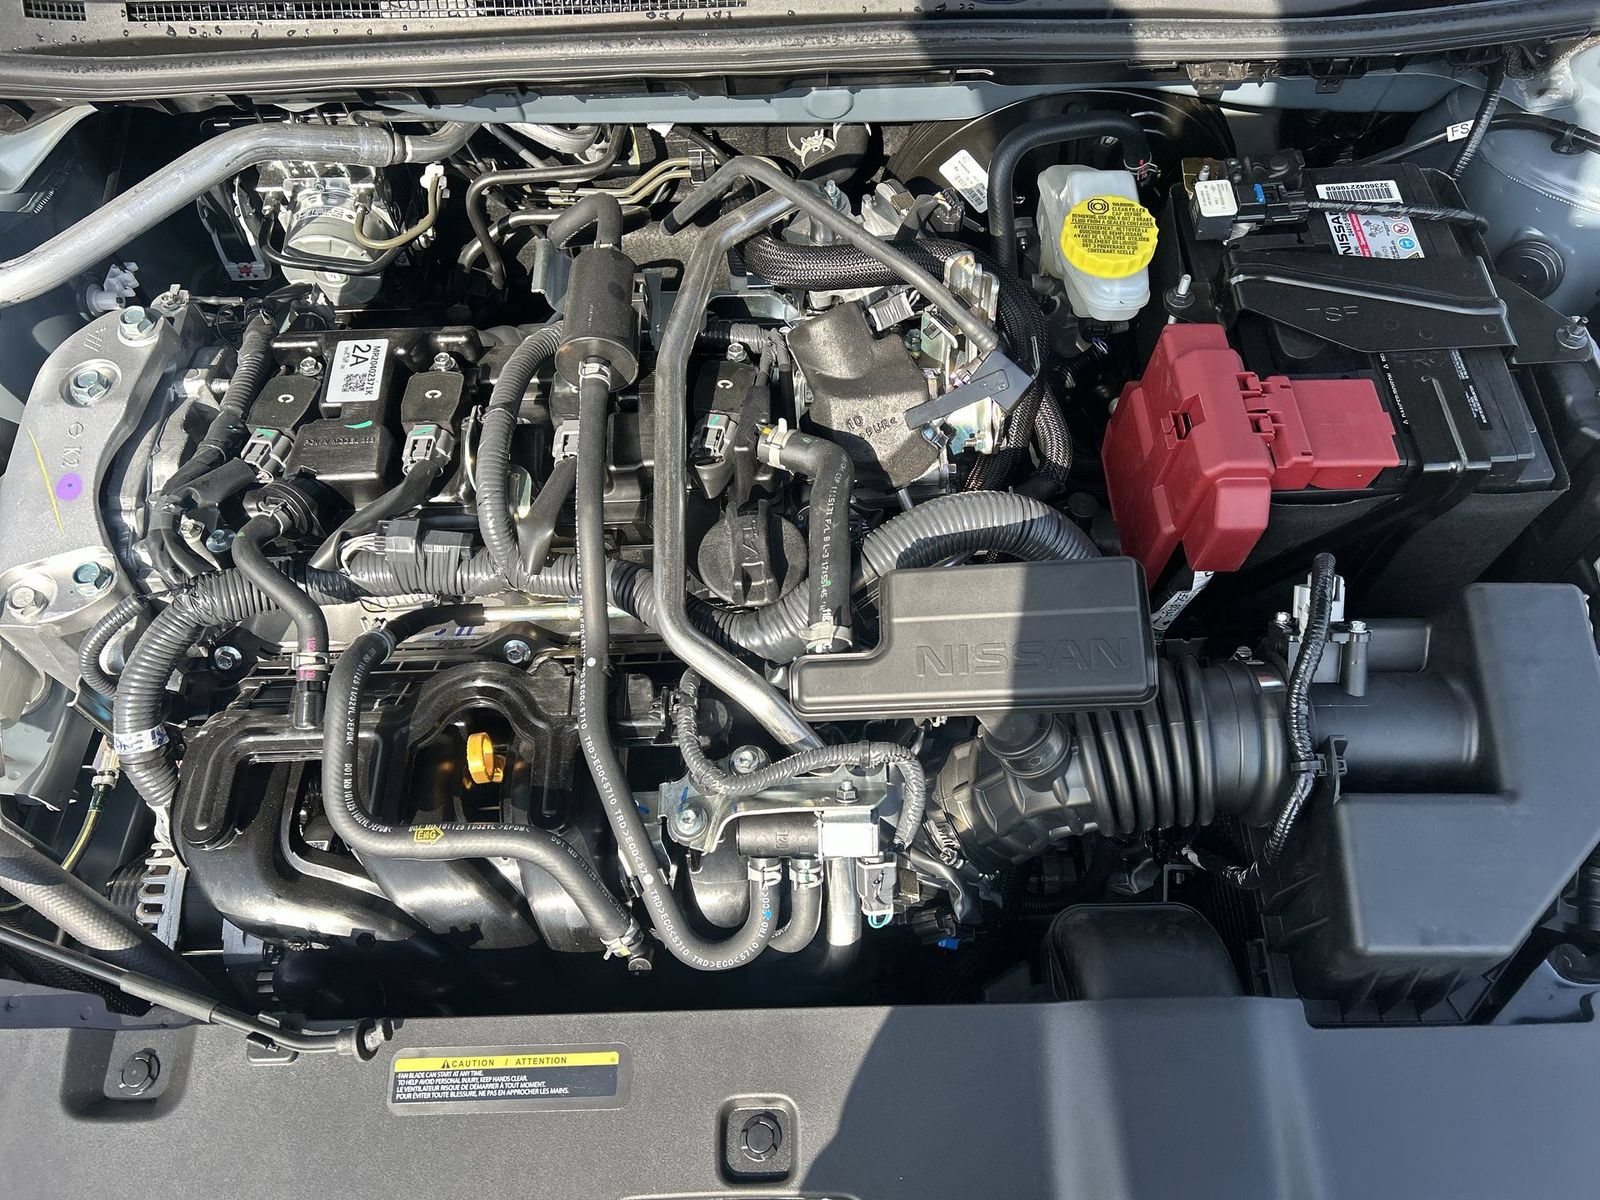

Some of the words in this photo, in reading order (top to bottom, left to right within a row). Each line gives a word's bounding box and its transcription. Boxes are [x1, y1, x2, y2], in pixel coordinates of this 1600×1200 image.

[1452, 123, 1469, 137] FS
[350, 344, 371, 367] 2A
[717, 380, 733, 389] C
[278, 394, 294, 403] C
[425, 389, 442, 398] C
[916, 637, 1129, 677] NISSAN
[344, 763, 352, 776] DOT
[452, 1059, 494, 1068] CAUTION
[515, 1056, 567, 1066] ATTENTION
[437, 1070, 452, 1078] START
[506, 1088, 539, 1096] APPROCHER
